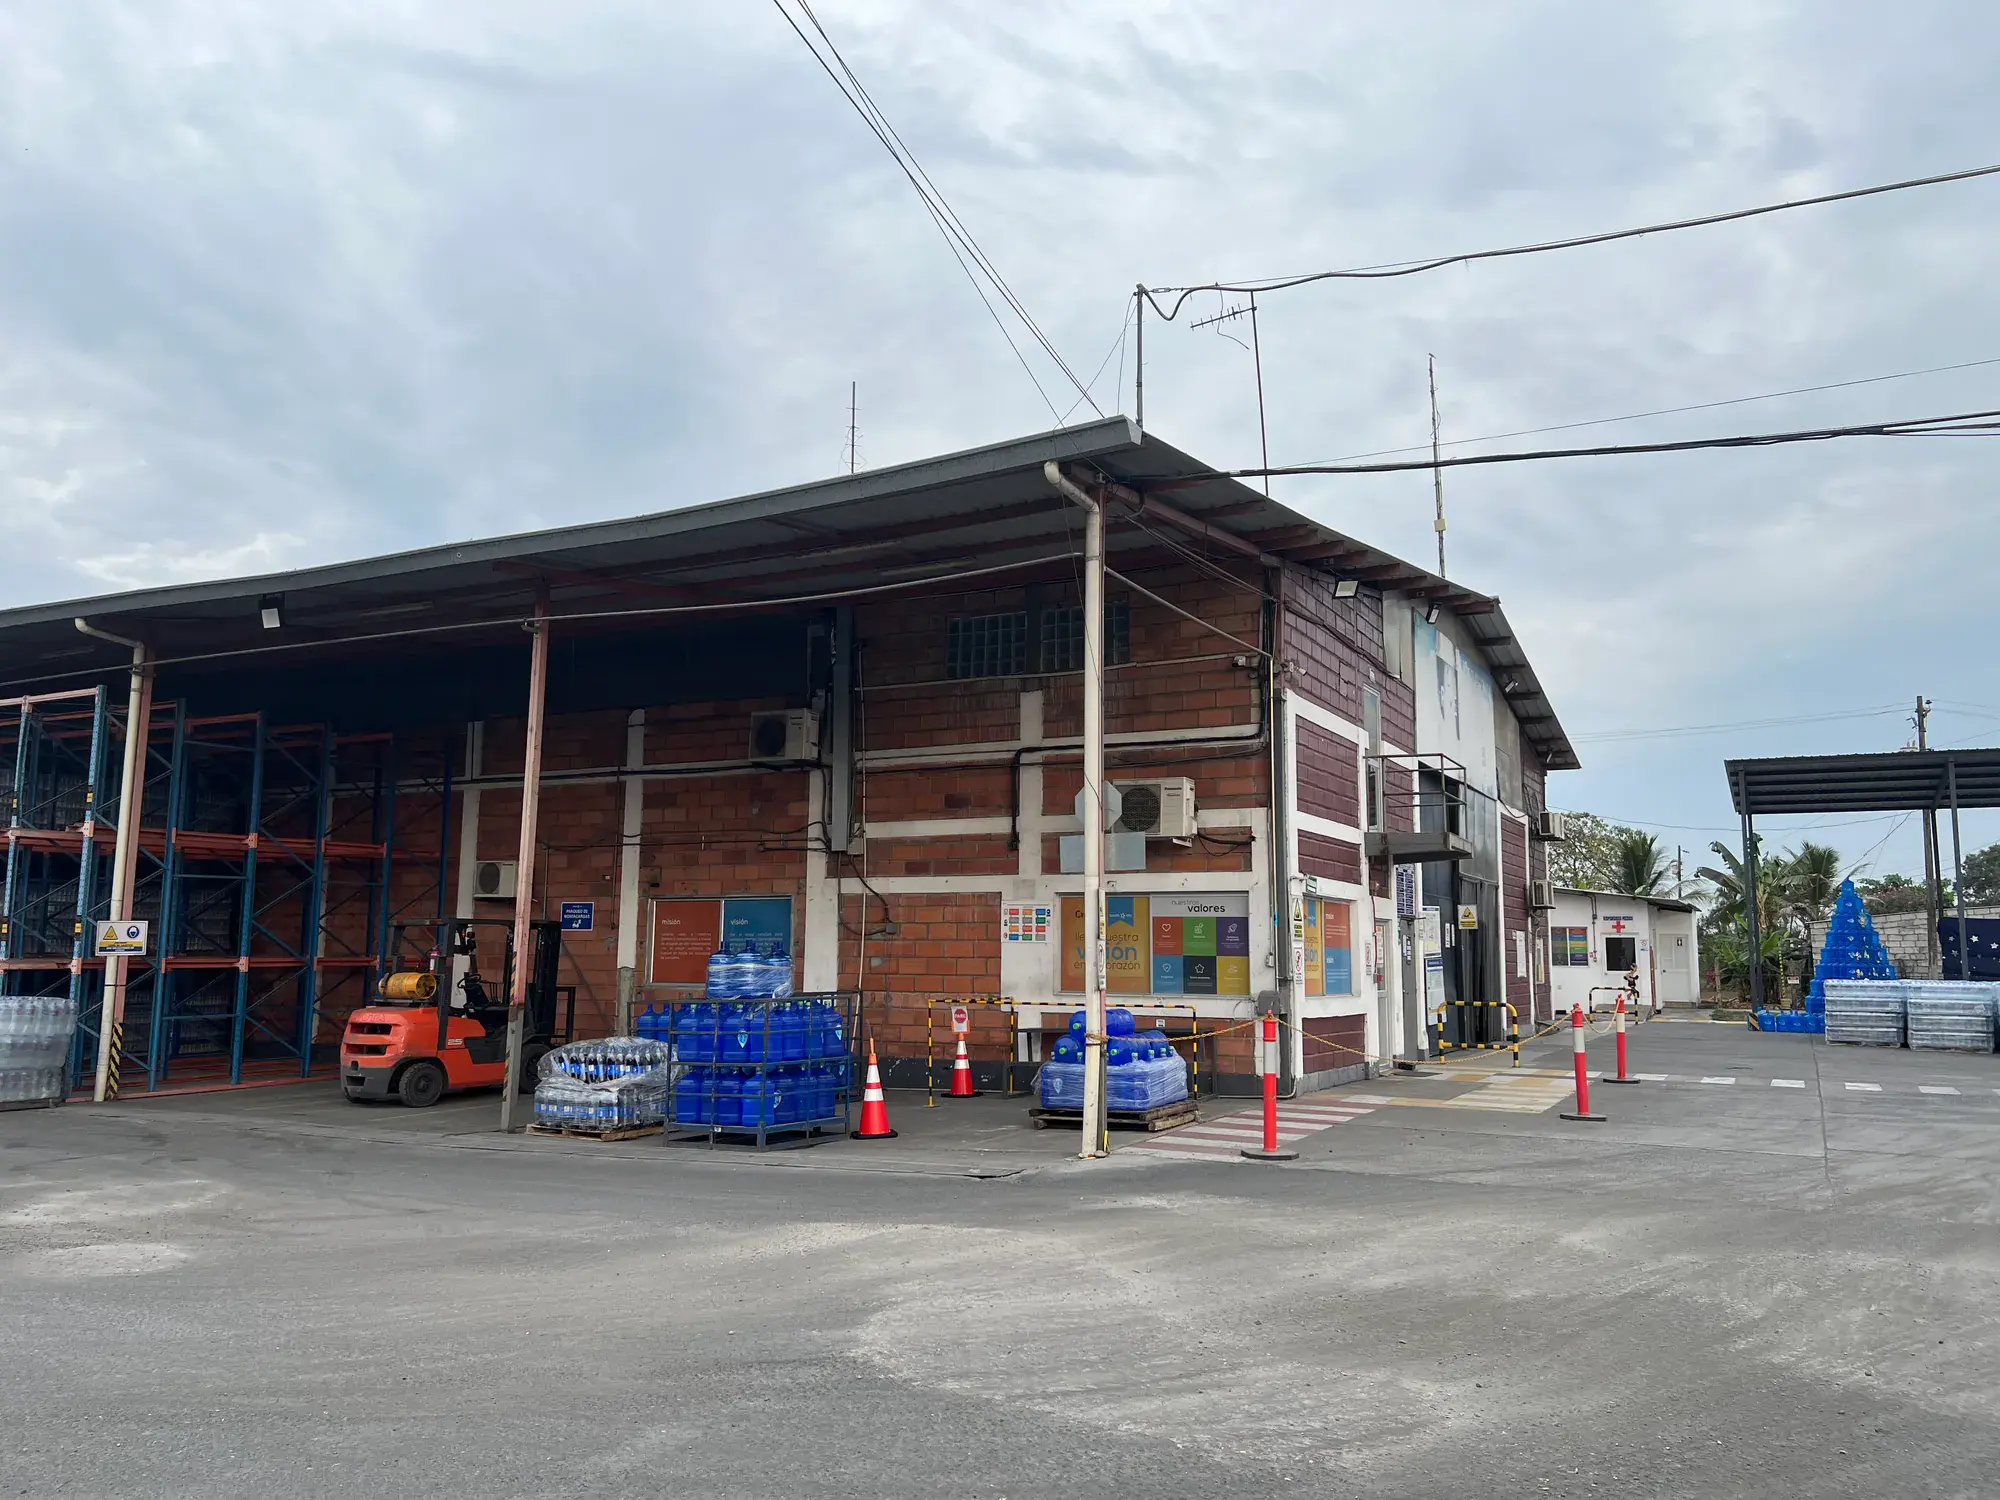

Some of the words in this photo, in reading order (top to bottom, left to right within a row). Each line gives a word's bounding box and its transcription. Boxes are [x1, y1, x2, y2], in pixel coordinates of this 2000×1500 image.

[1187, 903, 1226, 913] valores
[730, 918, 749, 926] visión
[1106, 932, 1139, 941] uestra
[1076, 941, 1137, 961] vión
[1106, 961, 1141, 970] orazón
